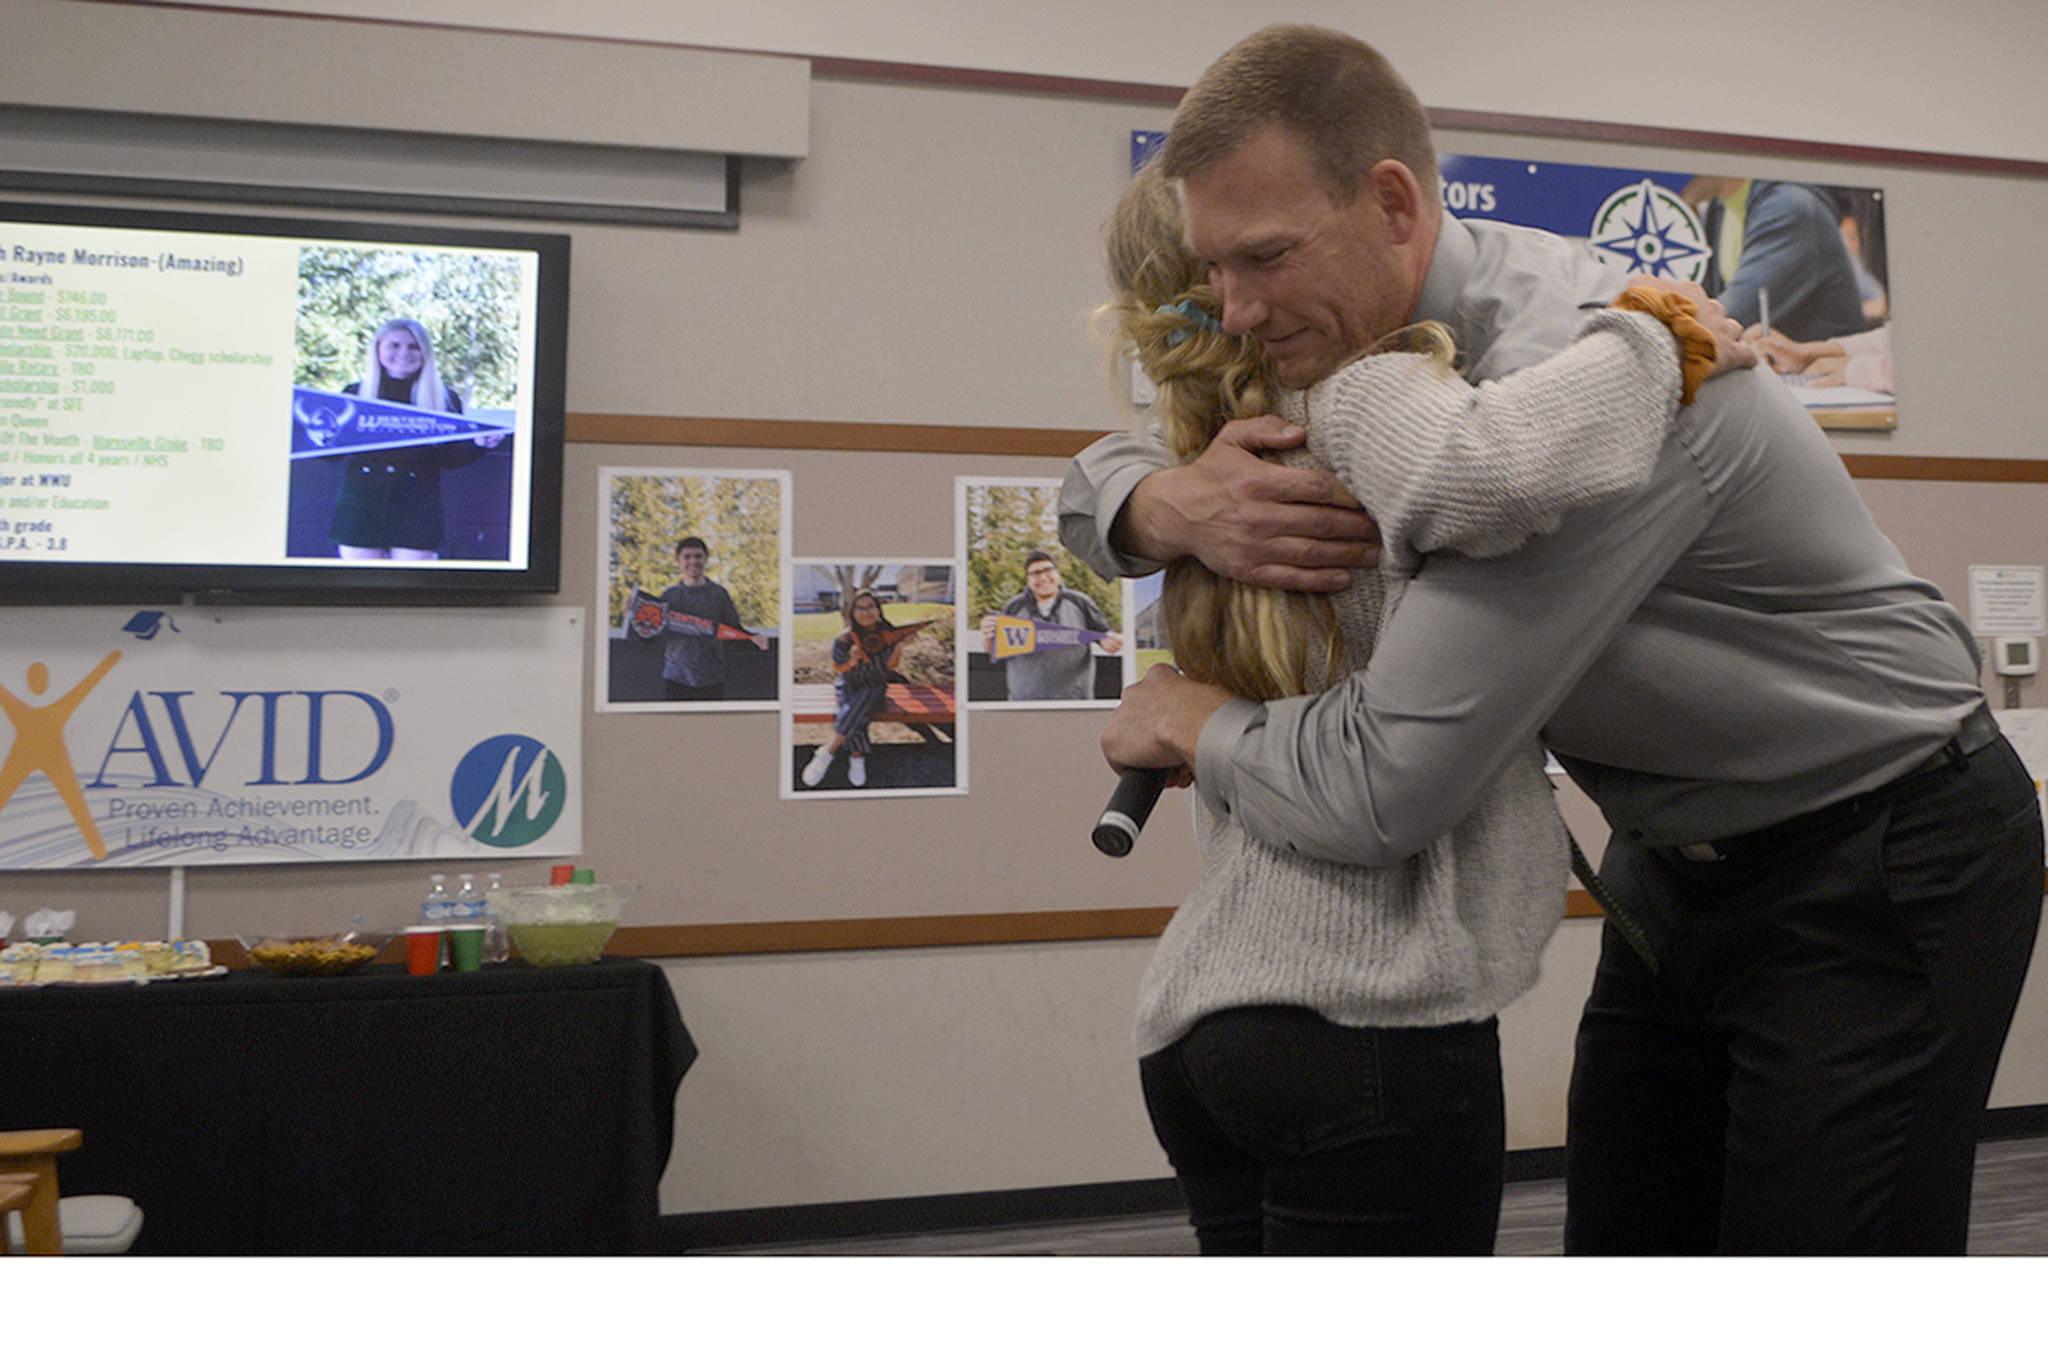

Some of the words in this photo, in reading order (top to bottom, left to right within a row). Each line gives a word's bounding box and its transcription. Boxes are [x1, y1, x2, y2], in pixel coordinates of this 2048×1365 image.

[13, 245, 66, 266] Rayne
[208, 349, 273, 366] scholarship
[98, 455, 129, 468] years
[21, 474, 35, 487] at
[52, 496, 109, 510] Education
[14, 519, 53, 534] grade
[1003, 626, 1031, 648] W
[109, 797, 197, 820] Proven
[206, 796, 380, 819] Achievement.
[126, 827, 228, 851] Lifelong
[238, 824, 379, 850] Advantage.
